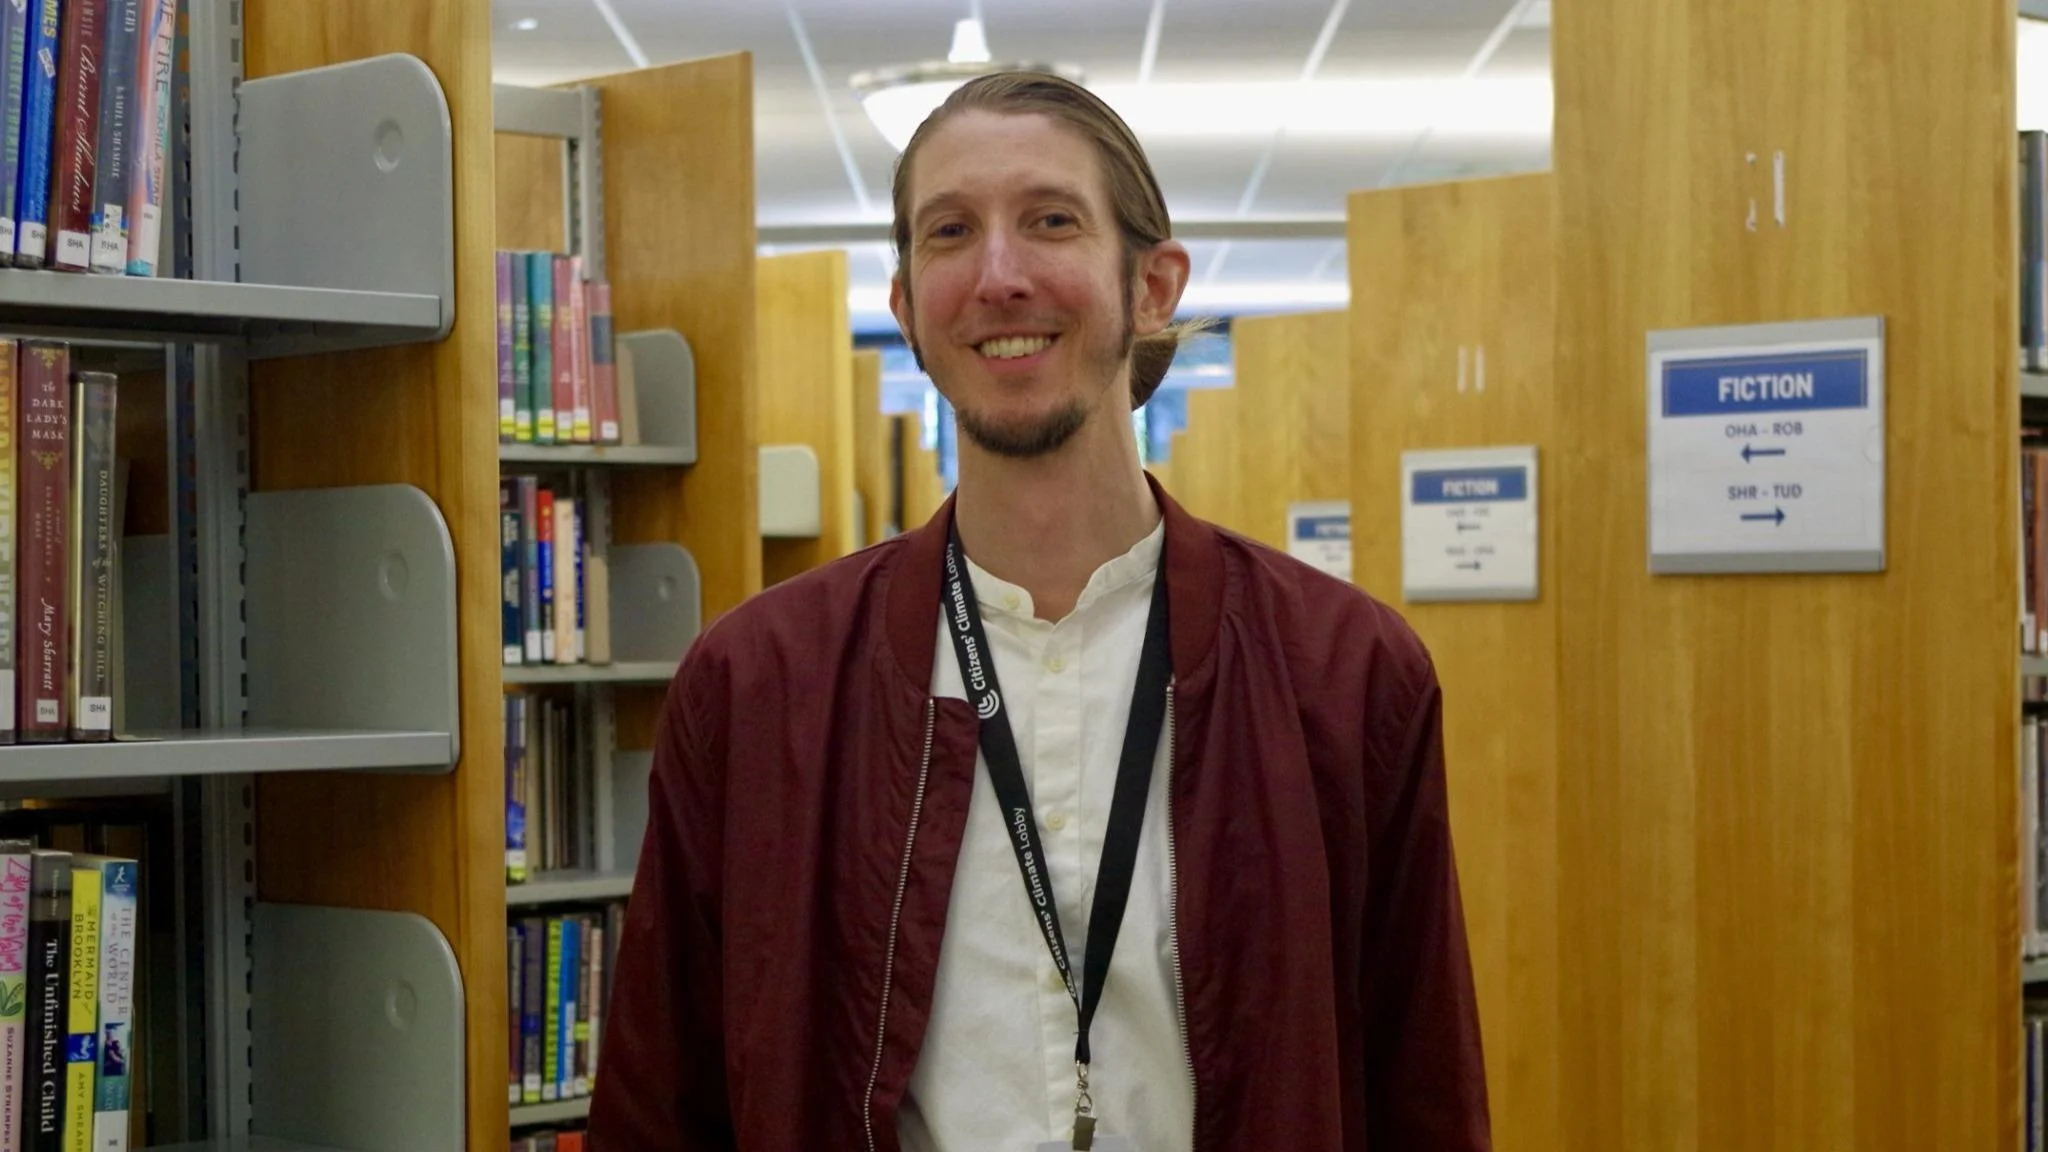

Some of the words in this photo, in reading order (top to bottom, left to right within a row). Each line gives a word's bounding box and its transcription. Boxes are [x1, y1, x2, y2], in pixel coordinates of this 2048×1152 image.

[77, 44, 98, 122] Burnt
[154, 34, 174, 94] FIRE
[73, 117, 95, 213] Shadows
[67, 237, 84, 249] SHA
[32, 398, 65, 409] DARK
[1717, 373, 1814, 403] FICTION
[26, 413, 68, 425] LADY'S
[31, 429, 65, 440] MASK
[1725, 424, 1758, 438] OHA
[1772, 422, 1804, 436] ROB
[98, 470, 108, 549] DAUGHTERS
[1442, 477, 1499, 498] FICTION
[1727, 485, 1758, 501] SHR
[1773, 484, 1804, 499] TUD
[38, 597, 55, 636] Mary
[97, 574, 106, 644] WITCHING
[951, 581, 971, 632] Climate
[43, 640, 56, 690] Sharratt
[96, 649, 105, 682] HILL
[961, 635, 986, 691] Citizens'
[88, 703, 107, 713] SHA
[1013, 807, 1031, 850] Lobby
[1024, 851, 1047, 907] Climate
[120, 907, 132, 939] THE
[1040, 910, 1066, 970] Citizens'
[45, 938, 58, 968] The
[72, 914, 84, 999] BROOKLYN
[84, 921, 97, 1000] MERMAID
[106, 941, 119, 1003] WORLD
[118, 948, 130, 1014] CENTER
[42, 972, 59, 1074] Unfinished
[5, 1027, 14, 1080] SUZANNE
[40, 1080, 56, 1133] Child
[77, 1072, 86, 1098] AMY
[4, 1085, 13, 1144] STREMPEK
